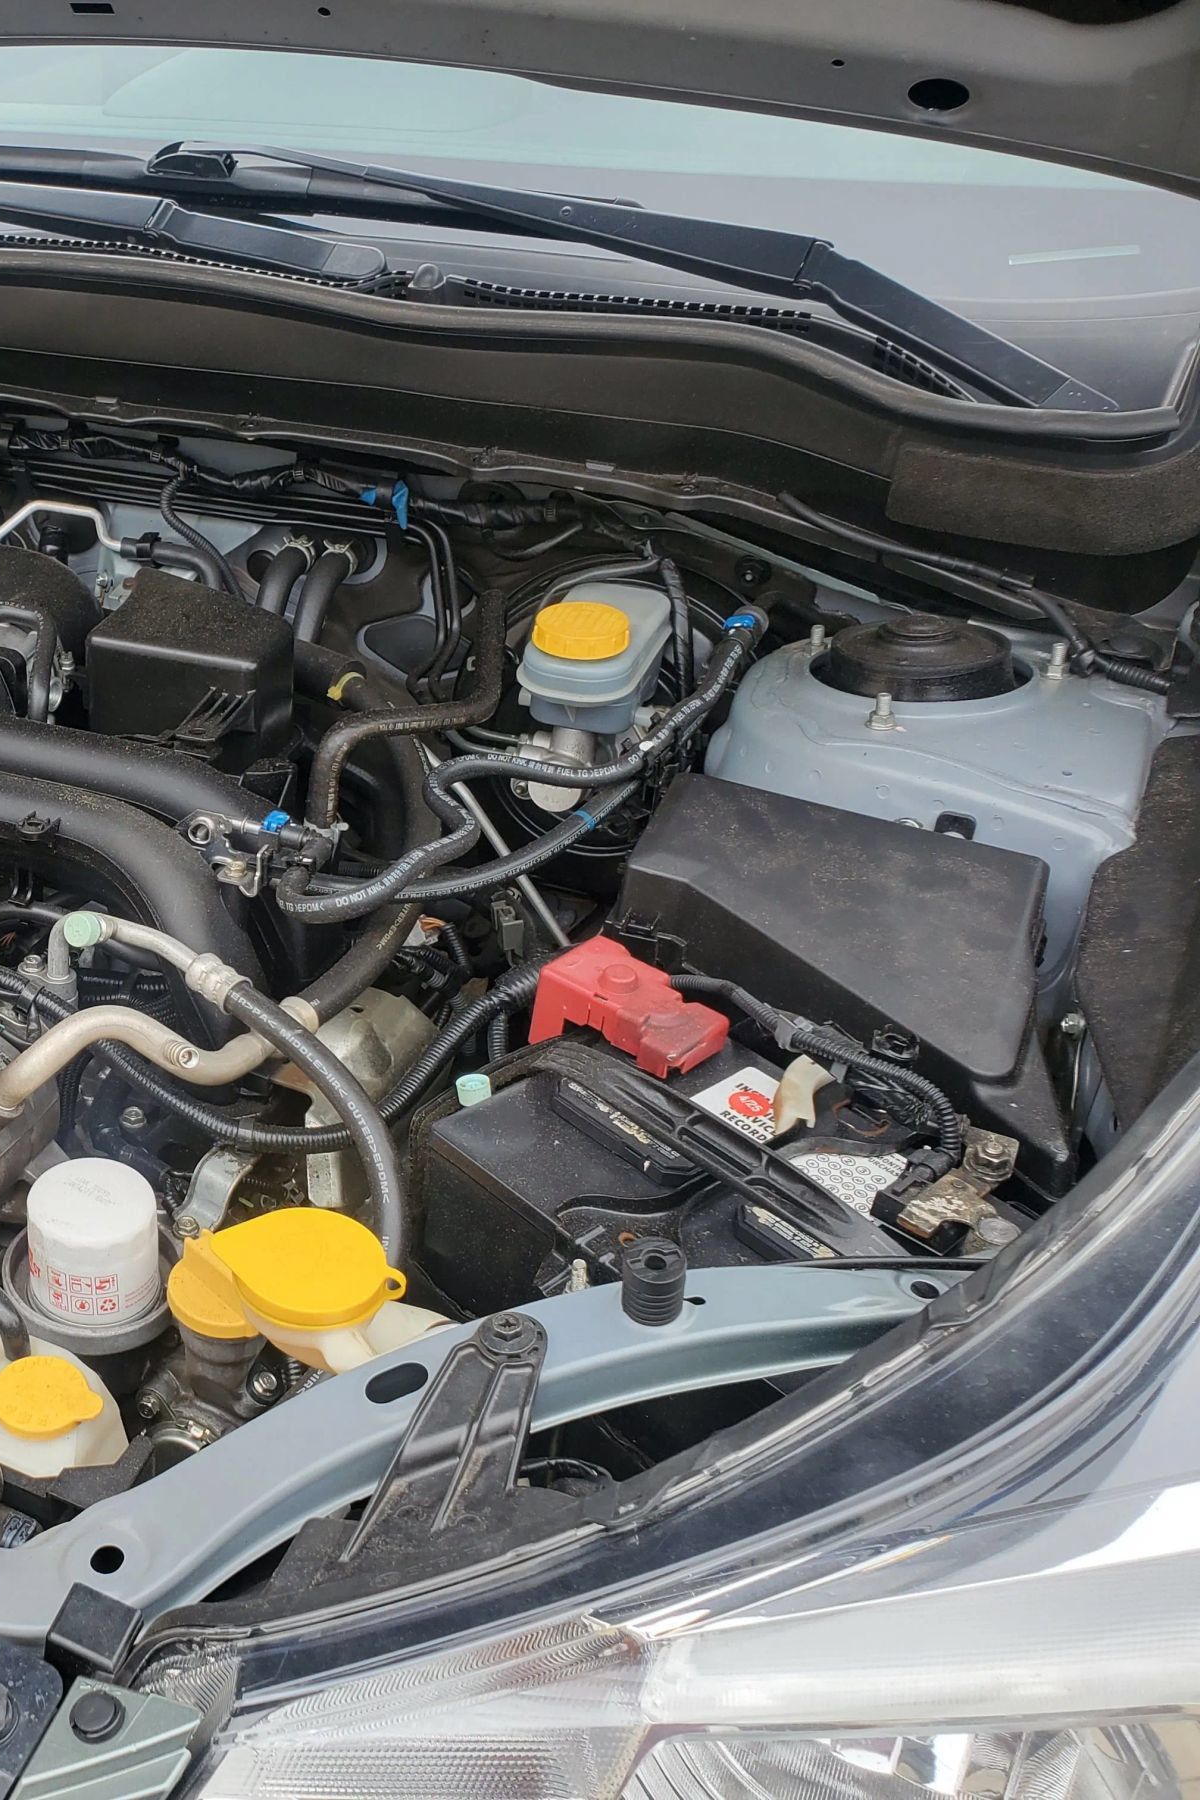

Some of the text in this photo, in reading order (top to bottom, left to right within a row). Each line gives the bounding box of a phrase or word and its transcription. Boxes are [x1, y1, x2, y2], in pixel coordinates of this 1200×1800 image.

[487, 753, 498, 761] DO
[498, 754, 512, 763] NOT
[556, 765, 575, 777] FUEL
[576, 769, 588, 778] TG
[286, 901, 294, 912] TG
[335, 896, 349, 908] DO
[349, 889, 368, 904] NOT
[376, 903, 413, 951] UTER>EPDM<
[719, 1110, 768, 1142] RECORD
[867, 1157, 900, 1177] URCHAS
